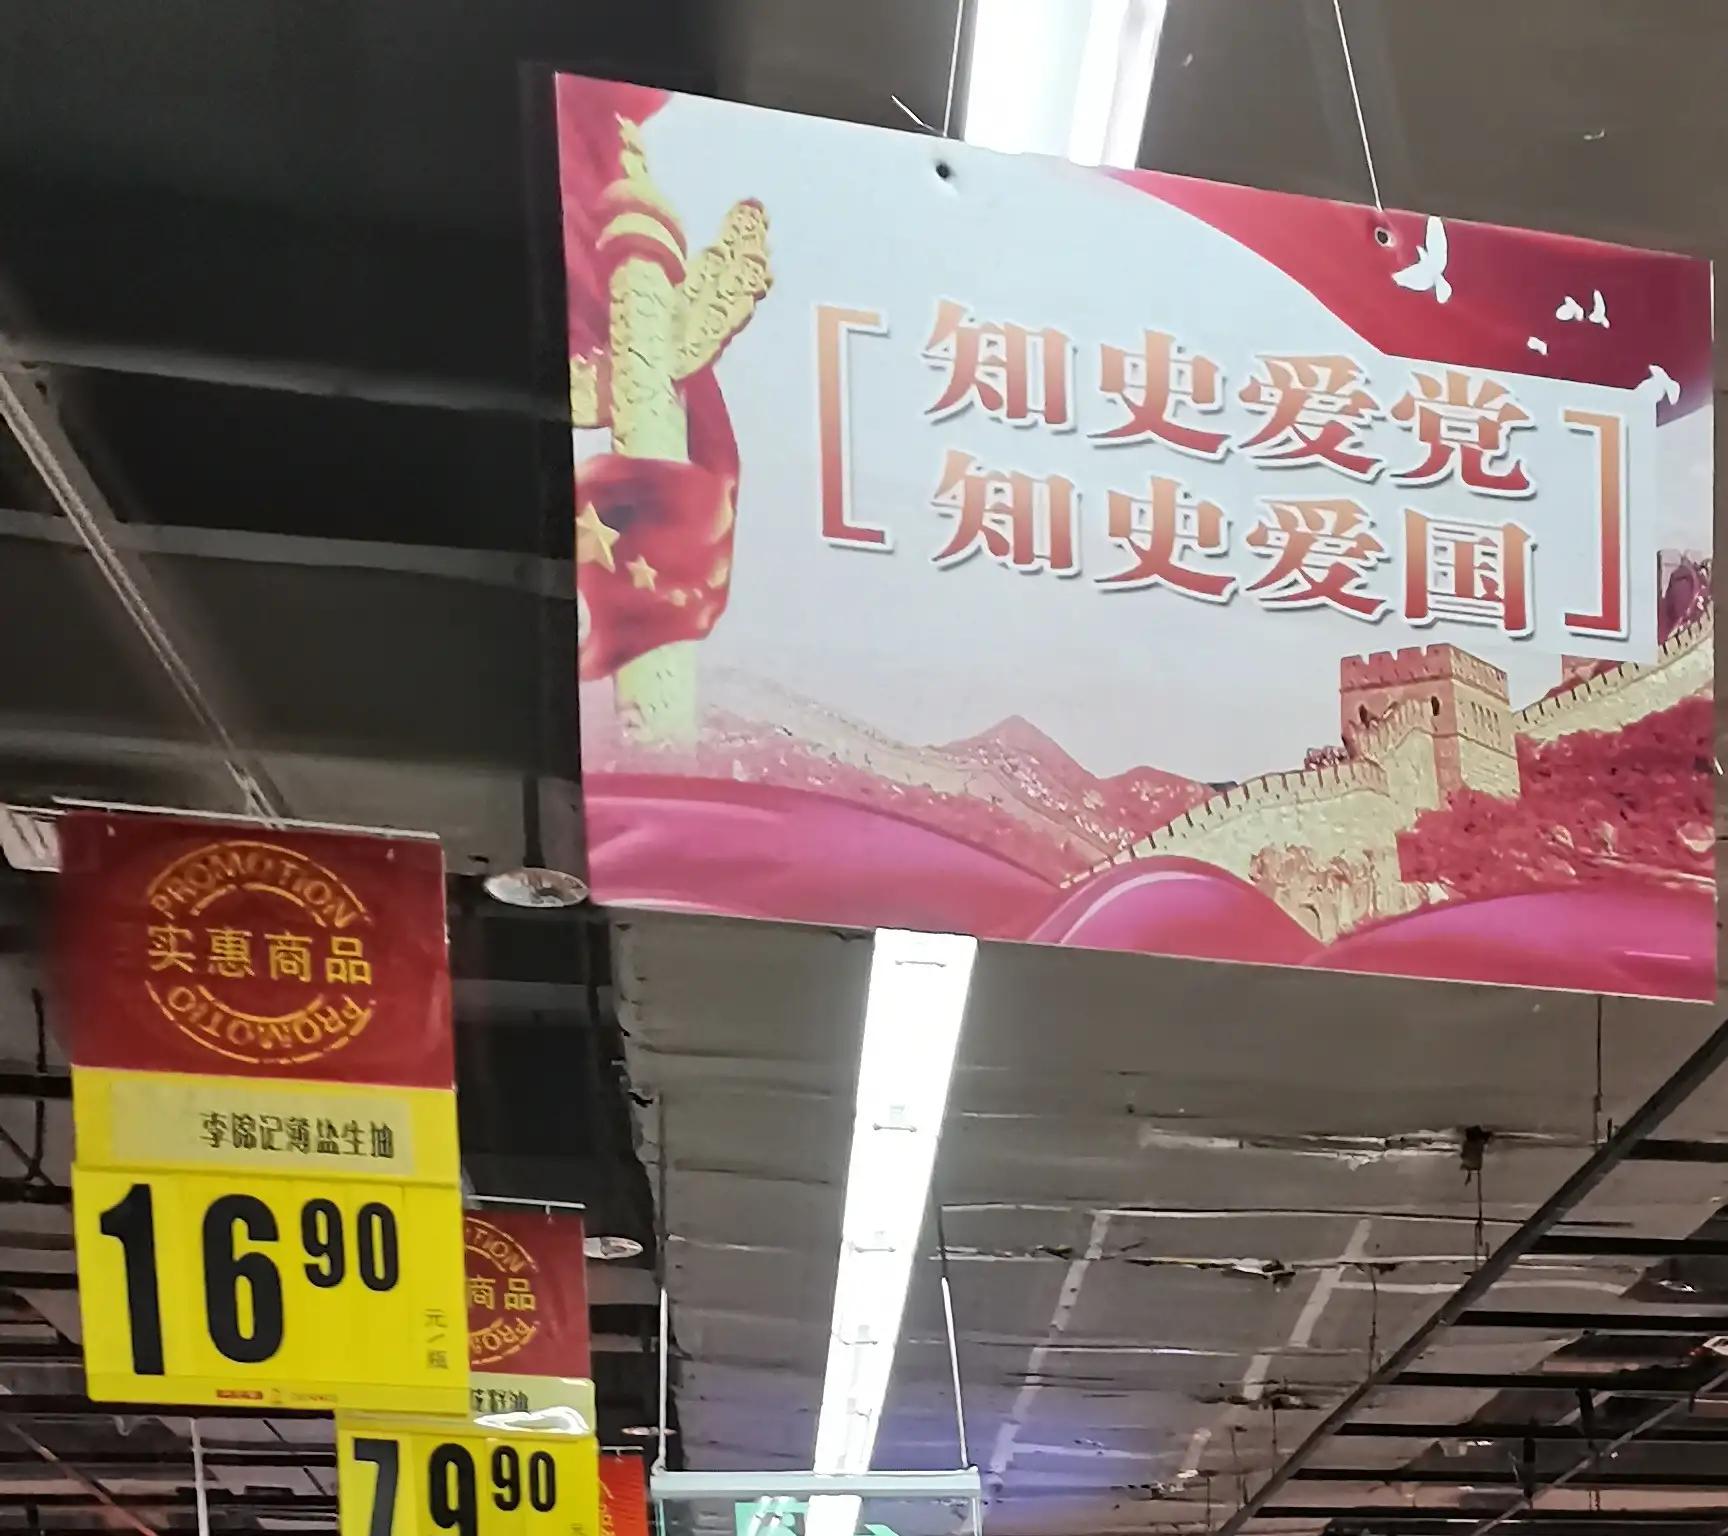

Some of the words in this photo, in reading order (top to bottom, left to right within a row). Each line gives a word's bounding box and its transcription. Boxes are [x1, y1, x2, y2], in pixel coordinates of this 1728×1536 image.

[921, 299, 1536, 497] 知史爱党
[932, 450, 1536, 634] 知史爱国
[147, 924, 374, 986] 实惠商品
